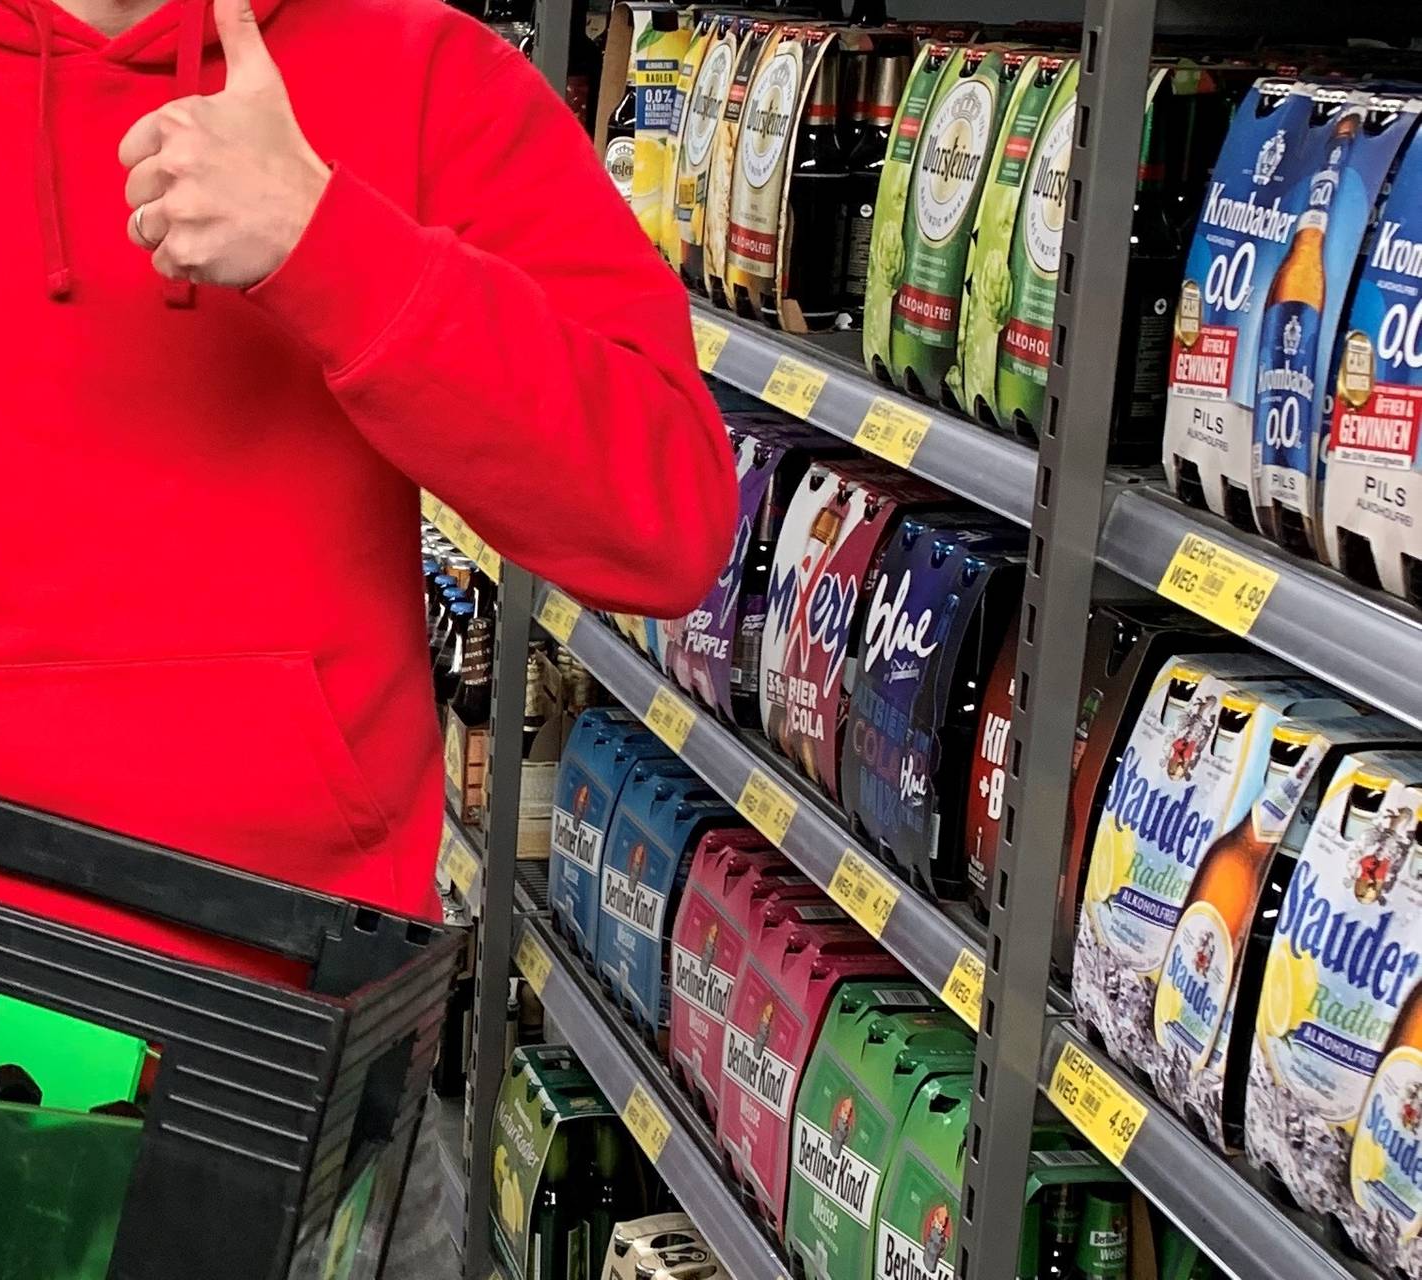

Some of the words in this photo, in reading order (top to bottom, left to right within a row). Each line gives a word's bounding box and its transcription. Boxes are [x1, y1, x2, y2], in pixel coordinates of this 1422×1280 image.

[645, 73, 673, 83] RADLER
[923, 134, 980, 182] Warsteiner
[1203, 181, 1298, 244] Krombacher
[899, 294, 952, 322] ALKOHOLFREI
[1175, 354, 1229, 384] GEWINNEN
[1193, 408, 1224, 434] PILS
[1339, 414, 1413, 451] GEWINNEN
[1272, 473, 1296, 490] PILS
[1364, 475, 1407, 507] PILS
[1179, 535, 1216, 567] MEHR
[1167, 565, 1199, 593] WEG
[1233, 581, 1266, 612] 4,99
[864, 569, 939, 673] blue
[684, 631, 730, 660] PURPLE
[788, 676, 818, 710] BIER
[792, 709, 825, 741] COLA
[899, 753, 929, 801] blue
[1105, 745, 1216, 870] Stauder
[555, 813, 577, 855] Berliner
[576, 826, 598, 867] Kindl
[833, 874, 854, 898] WEG
[1123, 852, 1192, 904] Radler
[605, 873, 634, 919] Berliner
[633, 888, 658, 931] Kindl
[1278, 860, 1420, 1008] Stauder
[676, 952, 707, 1004] Berliner
[947, 976, 970, 1004] WEG
[1167, 943, 1218, 1027] Stauder
[1306, 982, 1391, 1043] Radler
[1303, 1026, 1378, 1069] ALKOHOLFREI
[726, 1032, 760, 1096] Berliner
[758, 1056, 787, 1109] Kindl
[1061, 1049, 1094, 1083] MEHR
[1055, 1073, 1080, 1106] WEG
[1108, 1109, 1136, 1143] 4,99
[797, 1124, 840, 1194] Berliner
[837, 1157, 871, 1214] Kindl
